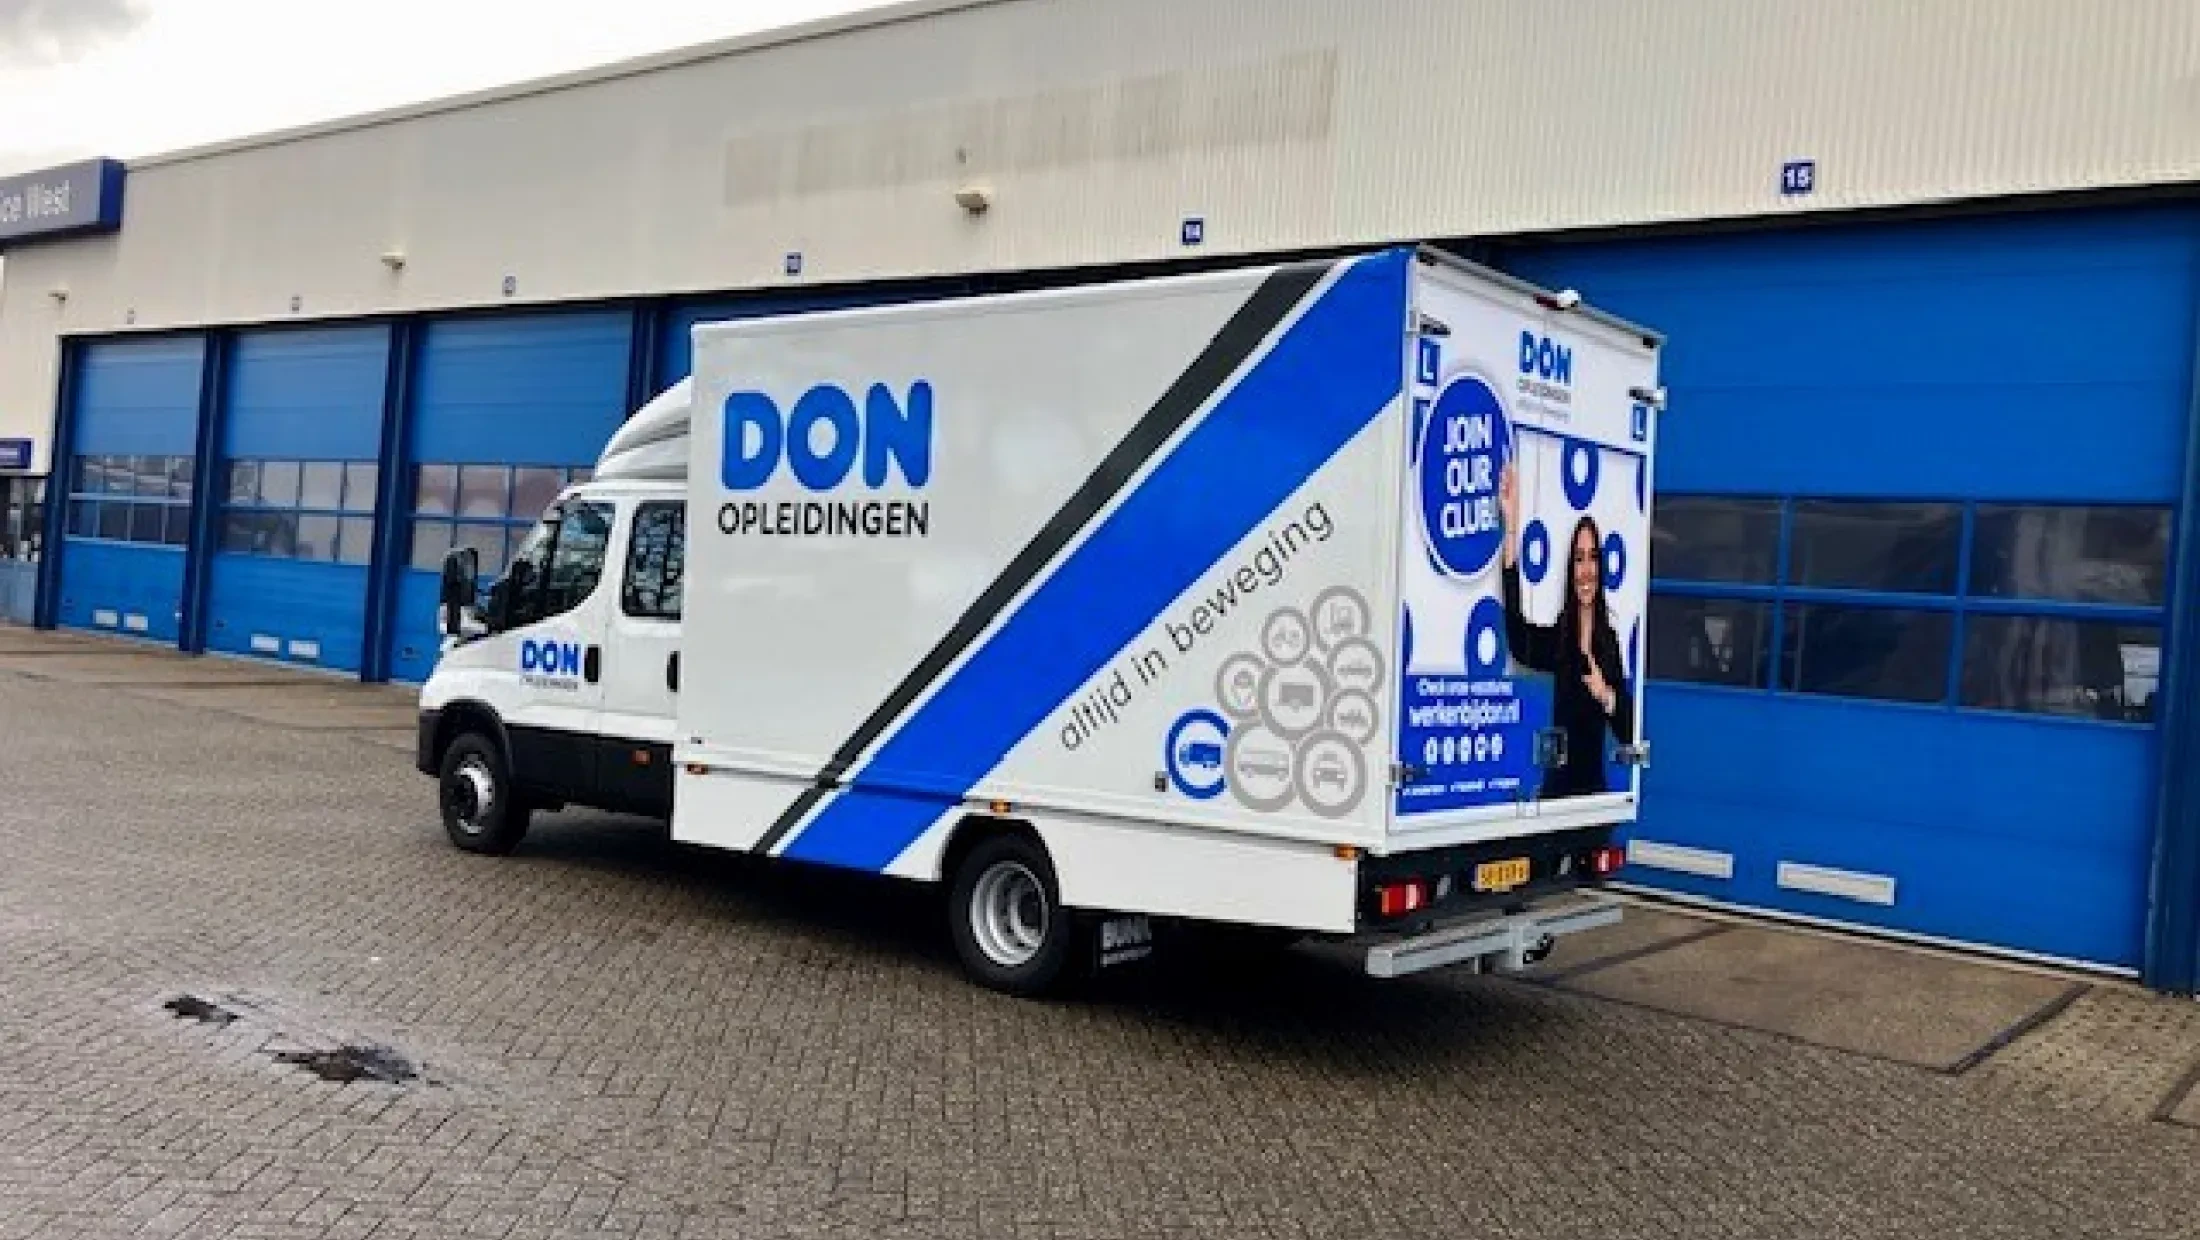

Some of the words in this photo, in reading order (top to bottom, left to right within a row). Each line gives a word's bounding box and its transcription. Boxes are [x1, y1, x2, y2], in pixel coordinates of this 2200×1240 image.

[1785, 166, 1810, 188] 15
[27, 180, 70, 218] West
[1518, 330, 1572, 387] DON
[721, 380, 933, 491] DON
[1443, 413, 1493, 453] JOIN
[1446, 453, 1493, 497] OUR
[717, 501, 930, 536] OPLEIDINGEN
[1061, 668, 1132, 750] altijd
[1130, 648, 1168, 686] in
[1165, 501, 1335, 654] beweging
[521, 639, 579, 676] DON
